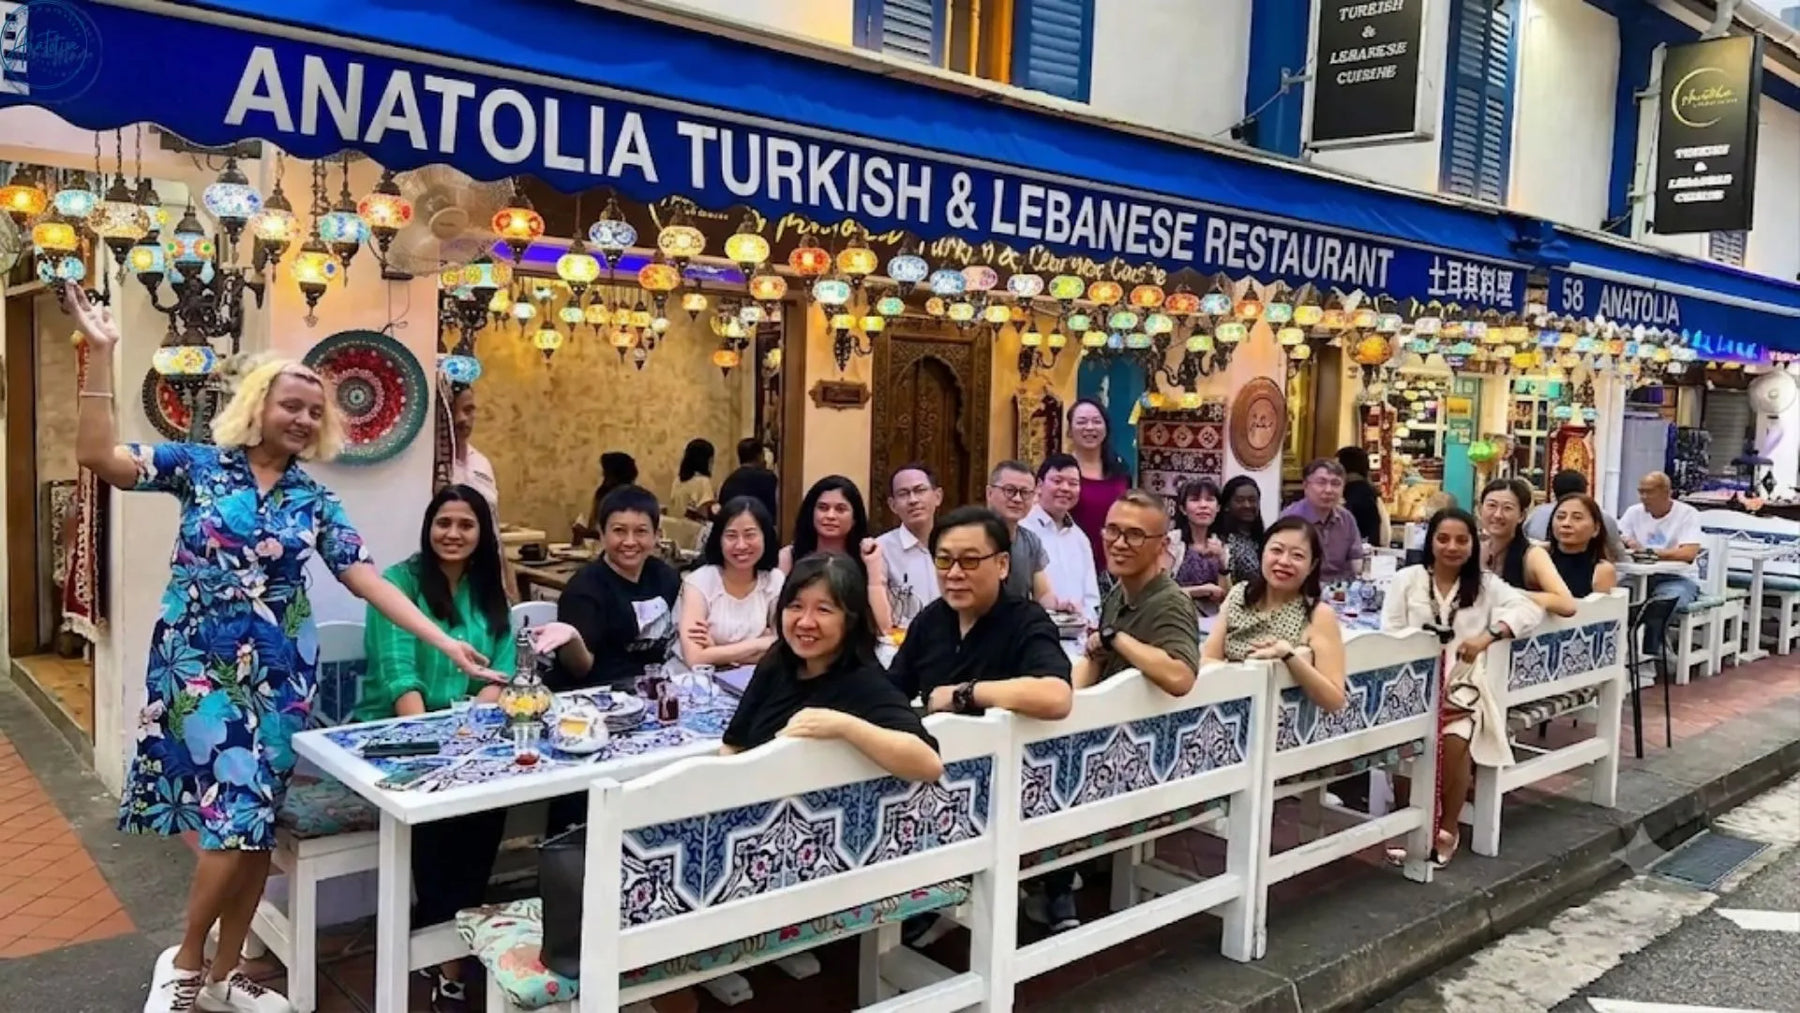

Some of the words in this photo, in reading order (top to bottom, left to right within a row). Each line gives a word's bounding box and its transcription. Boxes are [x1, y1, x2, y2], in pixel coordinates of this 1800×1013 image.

[223, 46, 659, 183] ANATOLIA
[677, 121, 931, 223] TURKISH
[946, 172, 979, 231] &
[991, 179, 1198, 261] LEBANESE
[1205, 218, 1394, 288] RESTAURANT
[1562, 278, 1584, 312] 58
[1600, 284, 1680, 325] ANATOLIA
